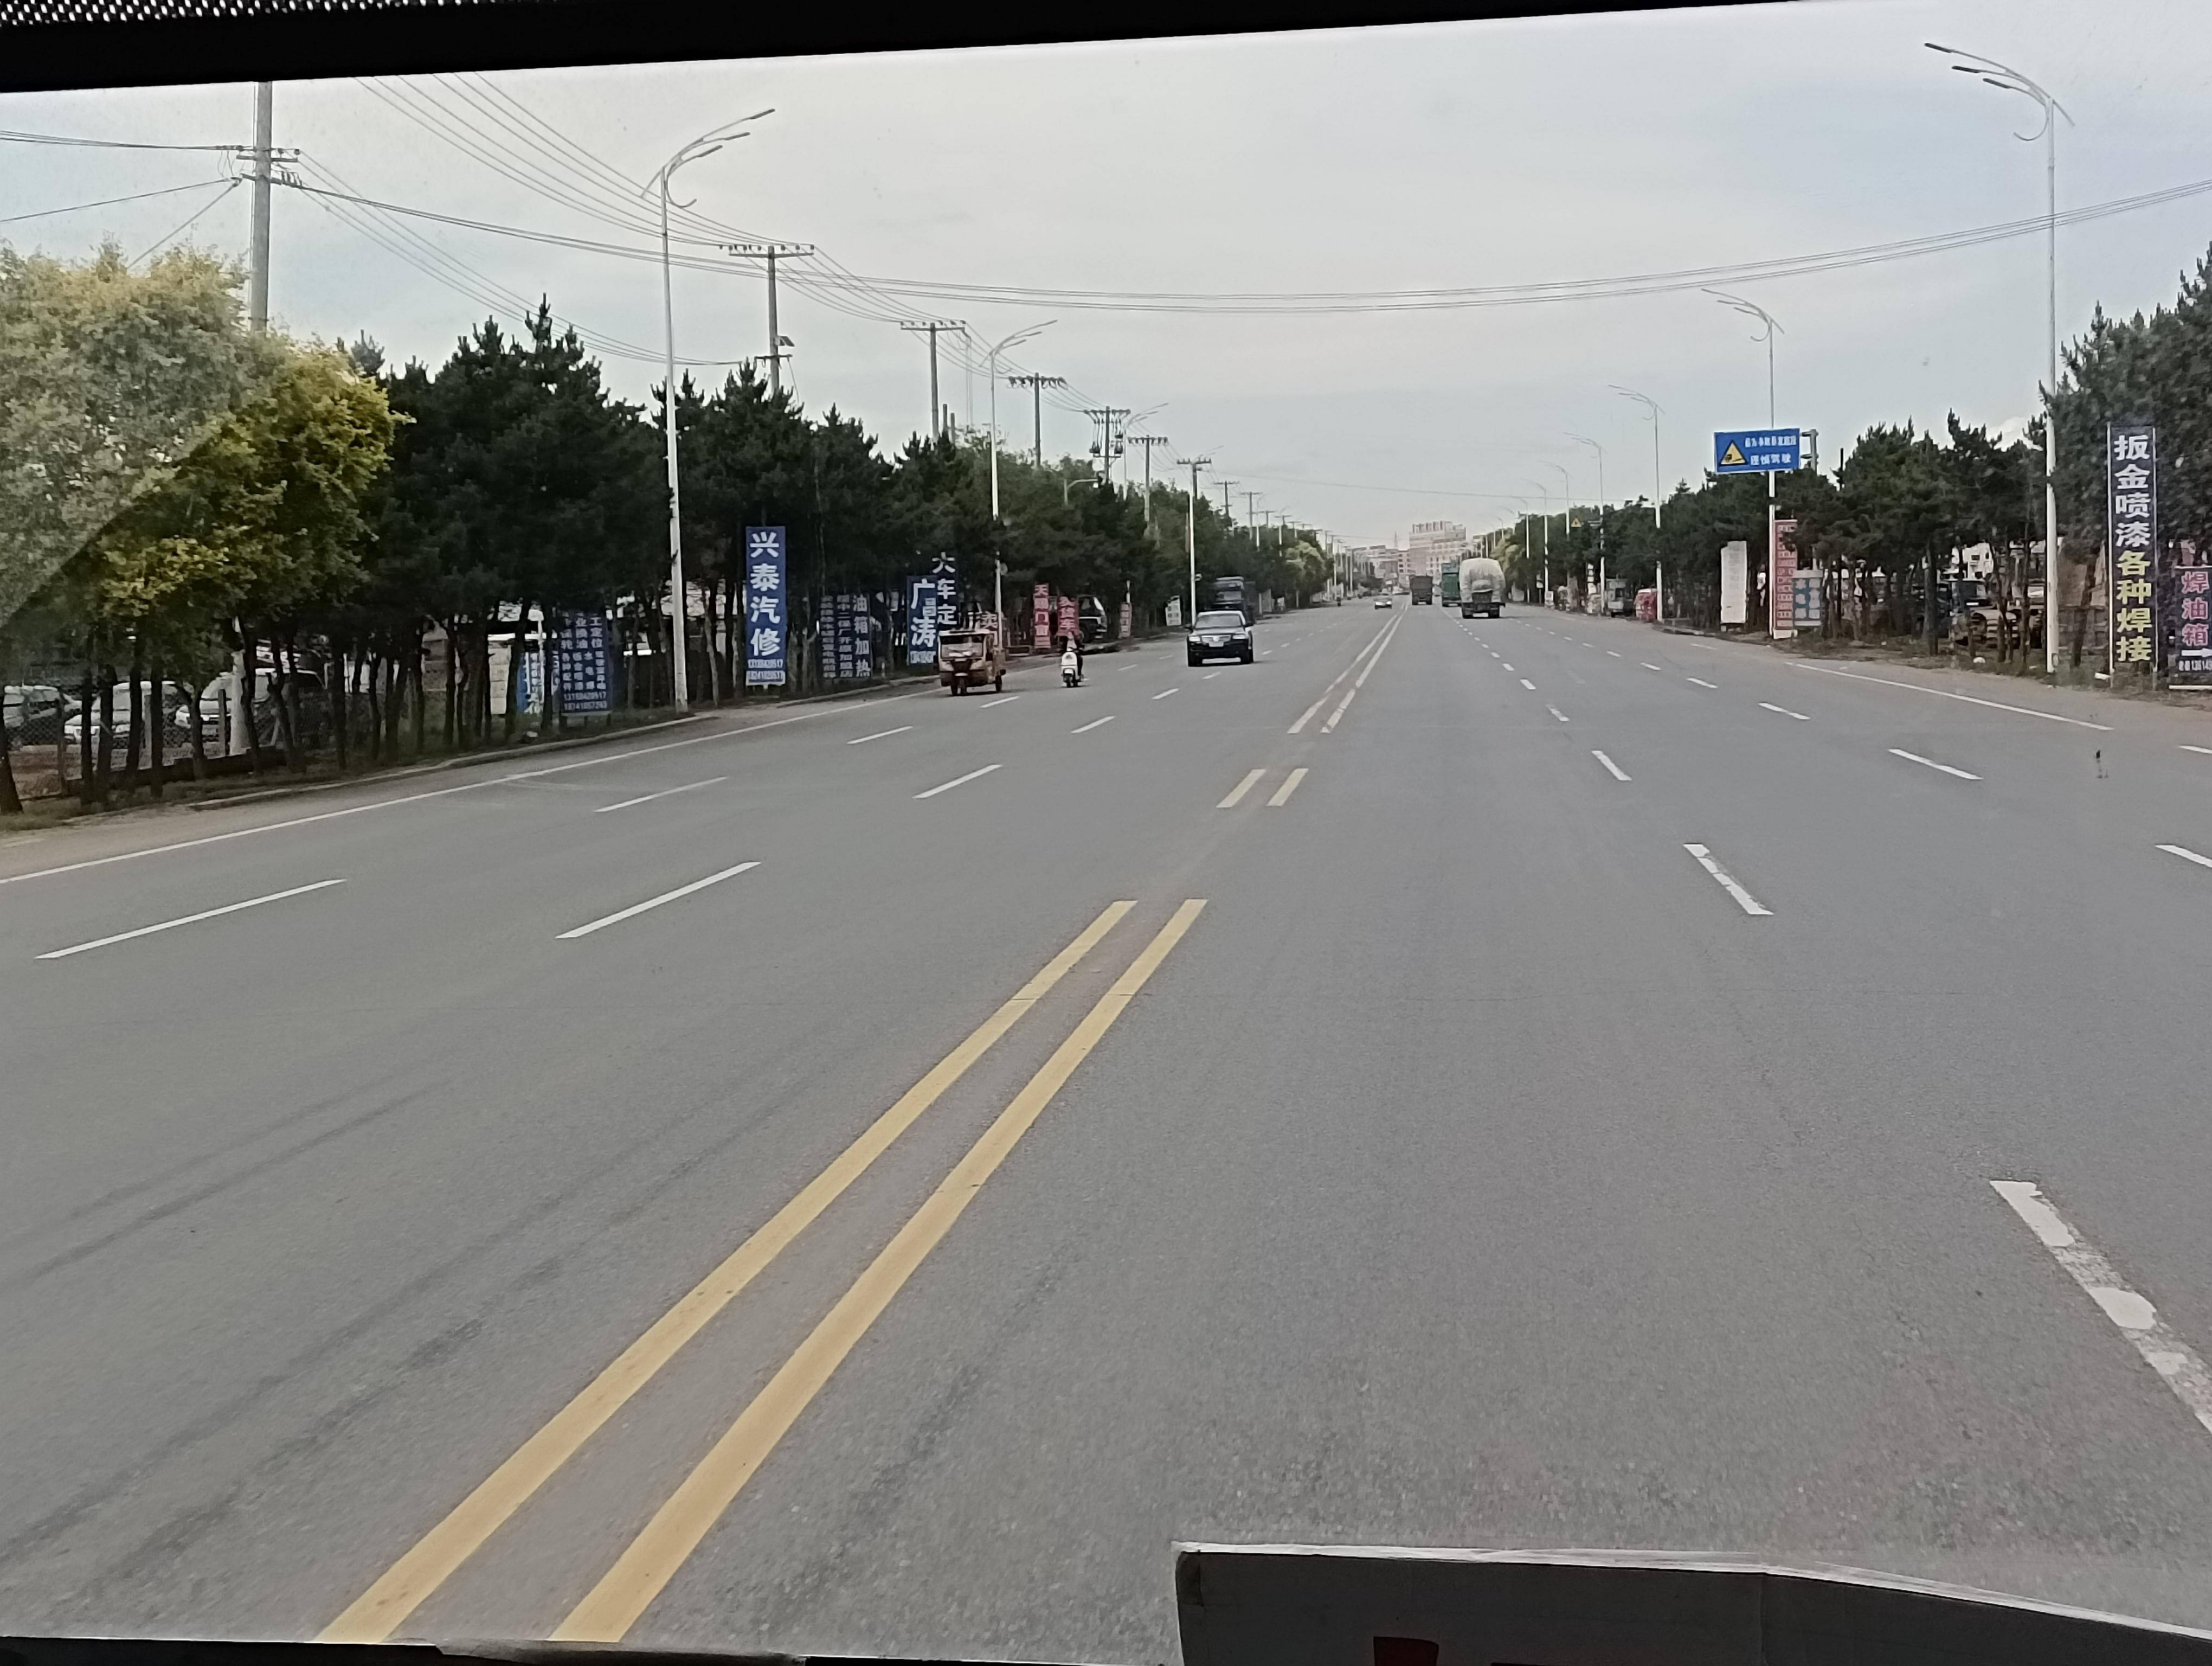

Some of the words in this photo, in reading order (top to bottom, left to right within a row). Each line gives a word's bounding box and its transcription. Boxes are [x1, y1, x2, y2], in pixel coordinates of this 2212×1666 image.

[750, 531, 781, 656] 兴泰汽修
[2114, 434, 2152, 661] 扳金喷漆各种焊接
[853, 594, 871, 677] 油箱加热
[2181, 571, 2210, 646] 焊油箱
